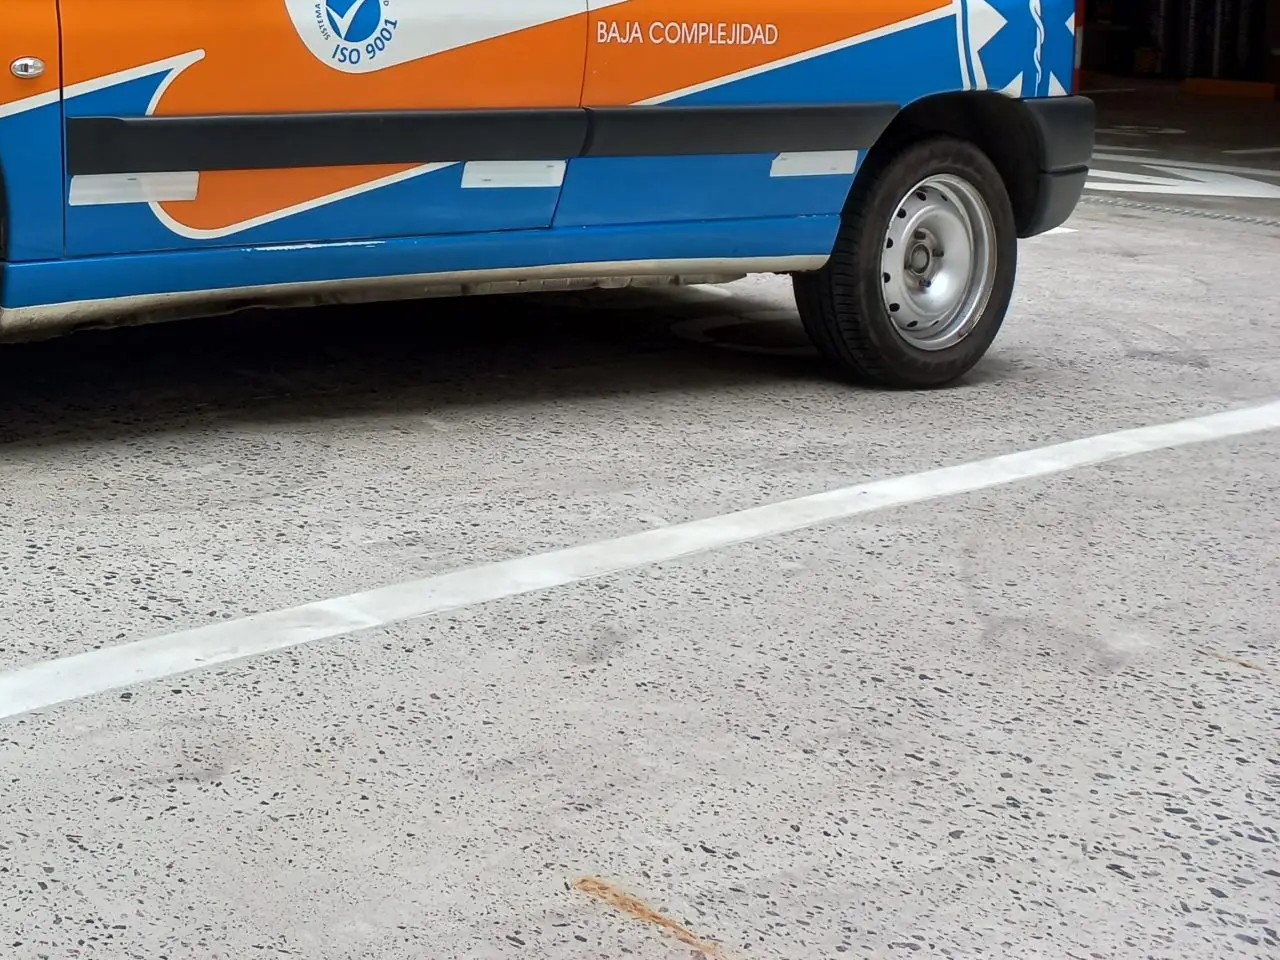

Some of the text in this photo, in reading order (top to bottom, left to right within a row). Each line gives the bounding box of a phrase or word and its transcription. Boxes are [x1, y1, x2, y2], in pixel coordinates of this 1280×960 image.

[315, 3, 331, 41] SISTEMA
[597, 21, 778, 45] BAJA COMPLEJIDAD
[332, 18, 398, 65] ISO 9001
